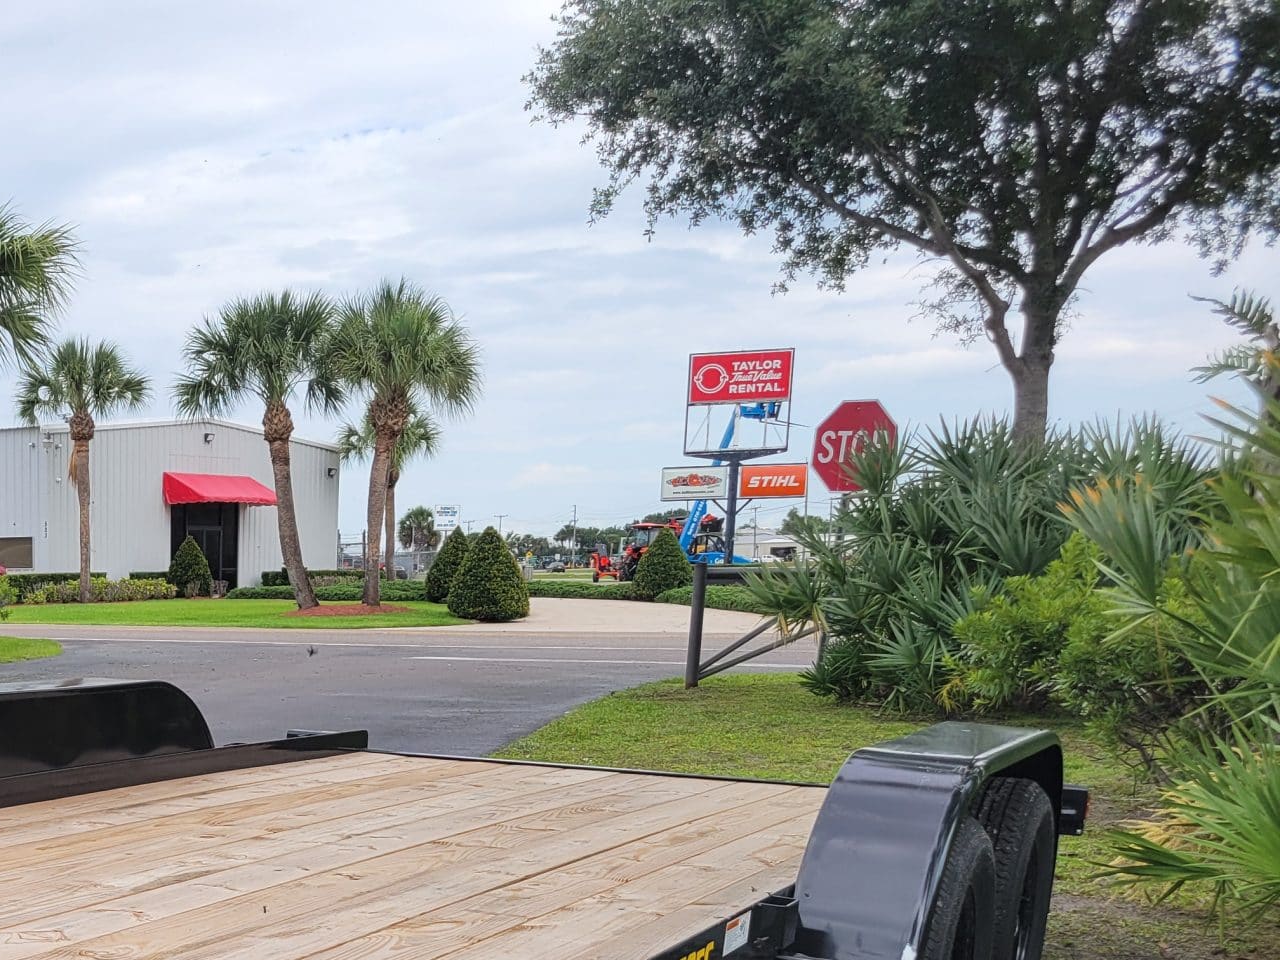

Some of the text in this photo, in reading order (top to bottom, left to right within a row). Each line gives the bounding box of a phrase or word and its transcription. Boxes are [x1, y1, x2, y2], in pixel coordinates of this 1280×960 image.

[732, 359, 782, 371] TAYLOR
[729, 382, 780, 394] RENTAL
[748, 475, 800, 488] STIHL
